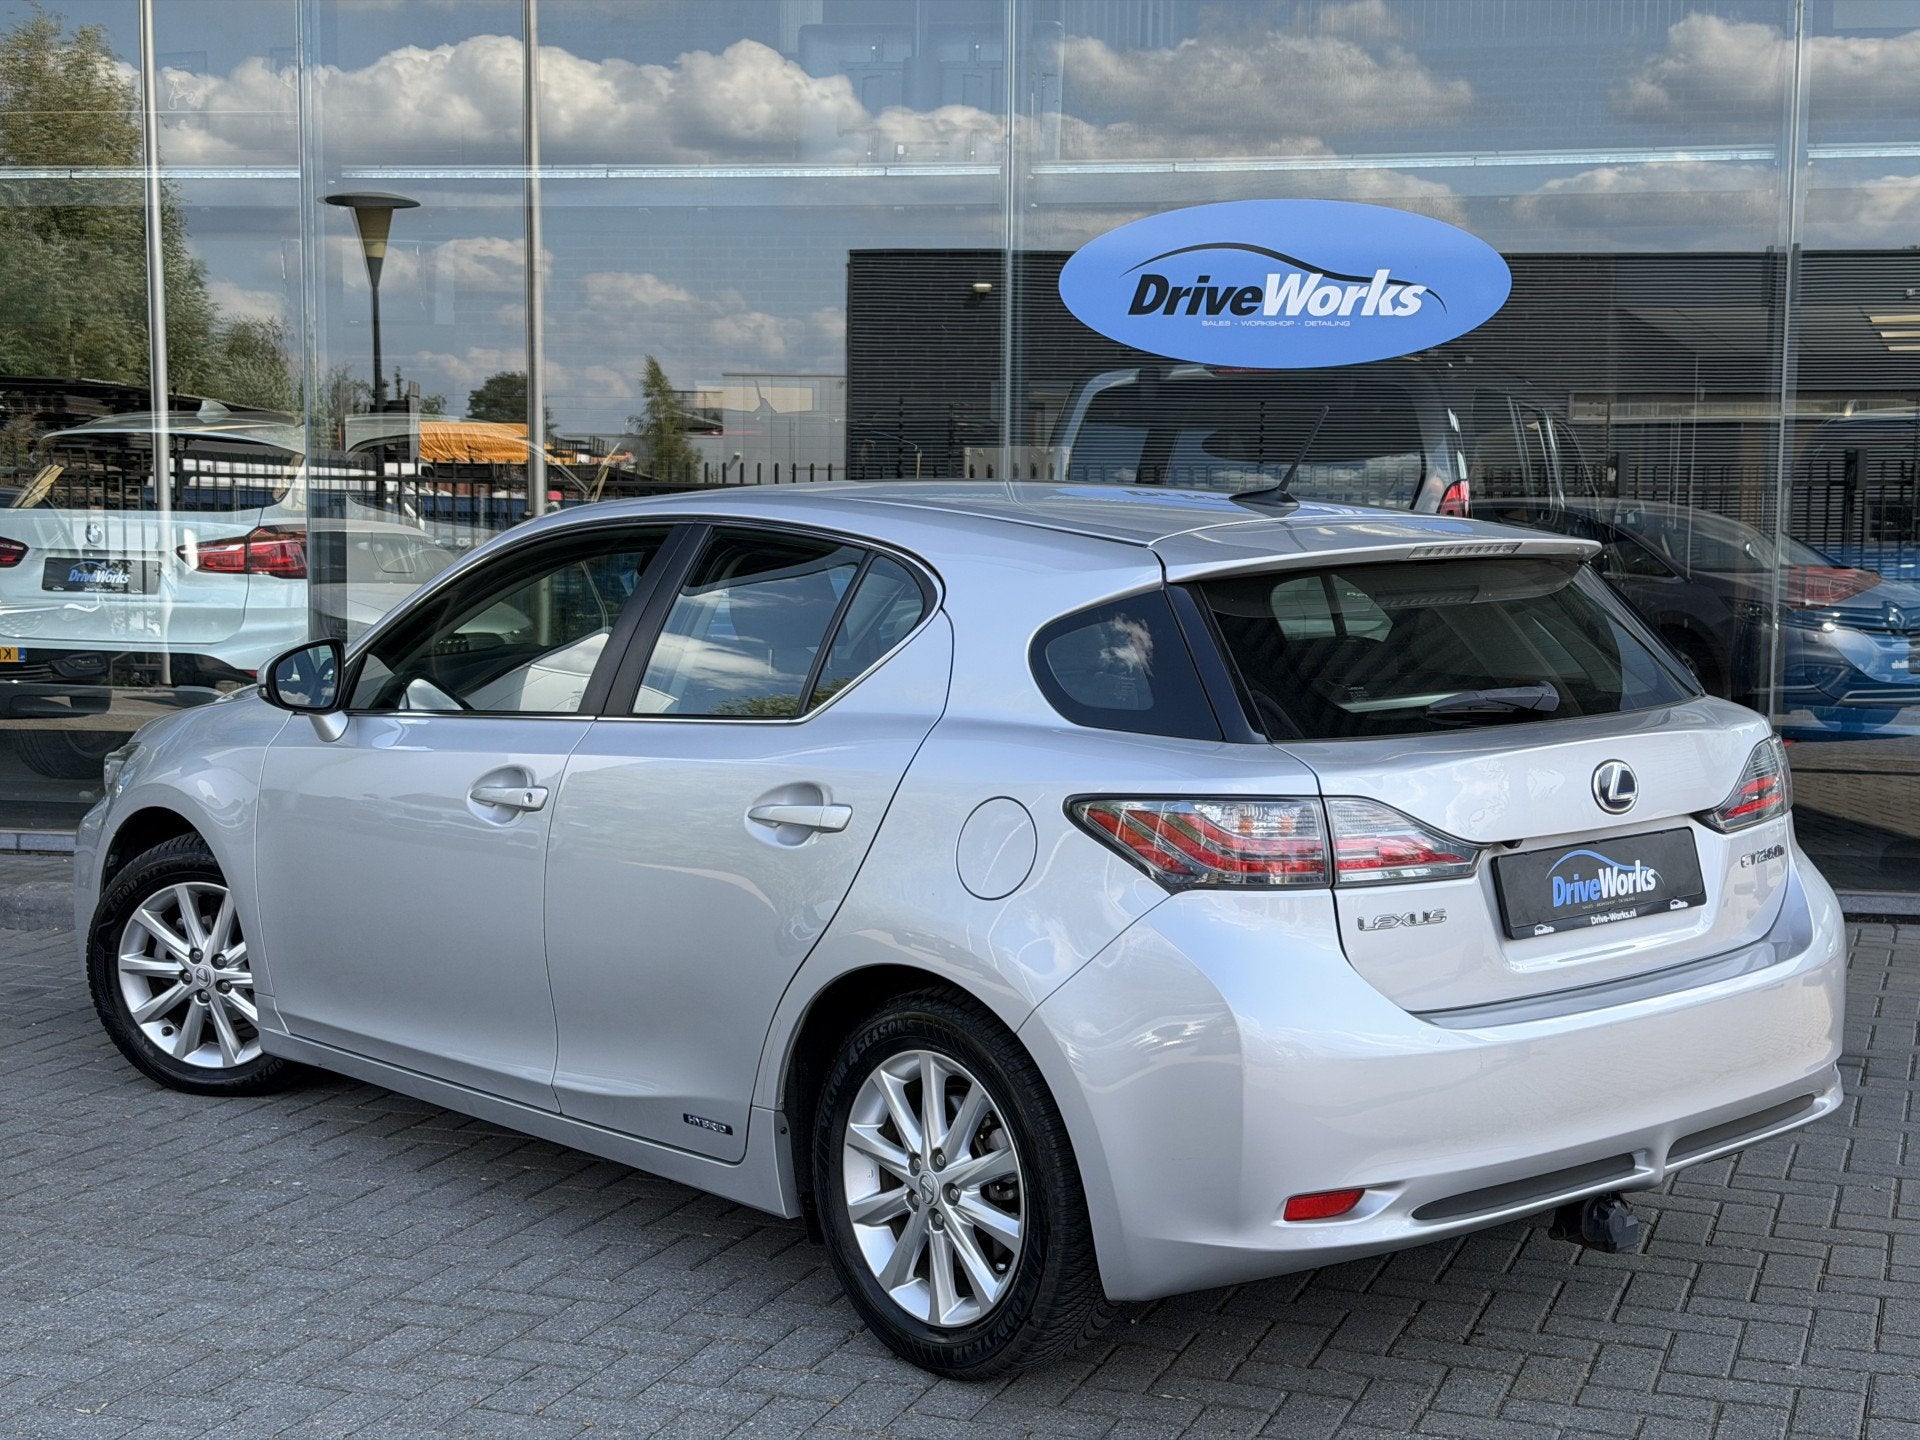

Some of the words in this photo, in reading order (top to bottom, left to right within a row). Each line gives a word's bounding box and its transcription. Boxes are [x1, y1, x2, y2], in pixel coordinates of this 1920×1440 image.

[1127, 268, 1428, 317] DriveWorks
[67, 568, 131, 584] DriveWorks
[1552, 859, 1656, 908] DriveWorks
[1357, 908, 1448, 931] LEXUS
[1590, 908, 1637, 925] Drive-Works.nl
